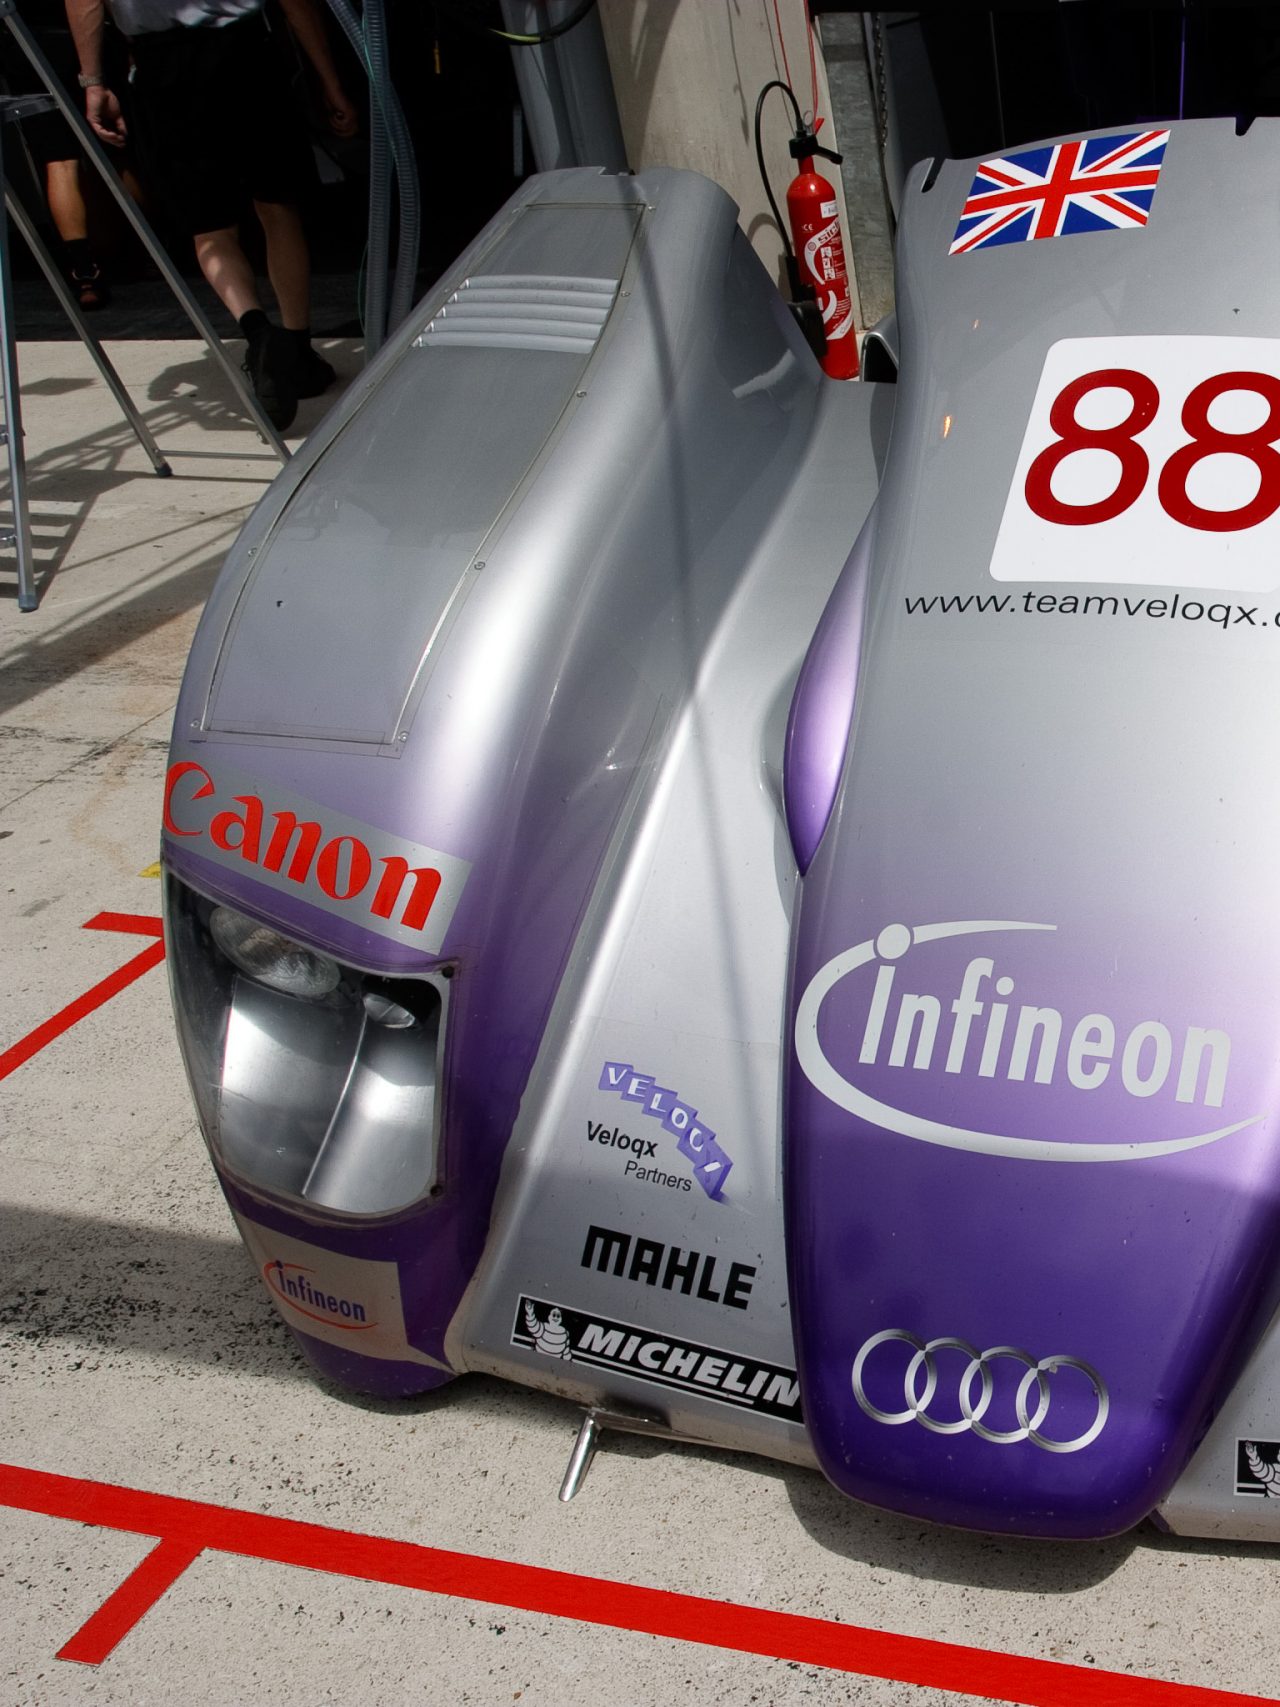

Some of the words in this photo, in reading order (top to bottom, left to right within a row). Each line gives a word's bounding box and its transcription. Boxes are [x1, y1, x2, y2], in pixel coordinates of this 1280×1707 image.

[163, 761, 442, 931] Canon
[587, 1120, 658, 1159] Veloqx
[624, 1160, 692, 1191] Partners
[581, 1224, 757, 1310] MAHLE
[577, 1323, 800, 1407] MICHELIN
